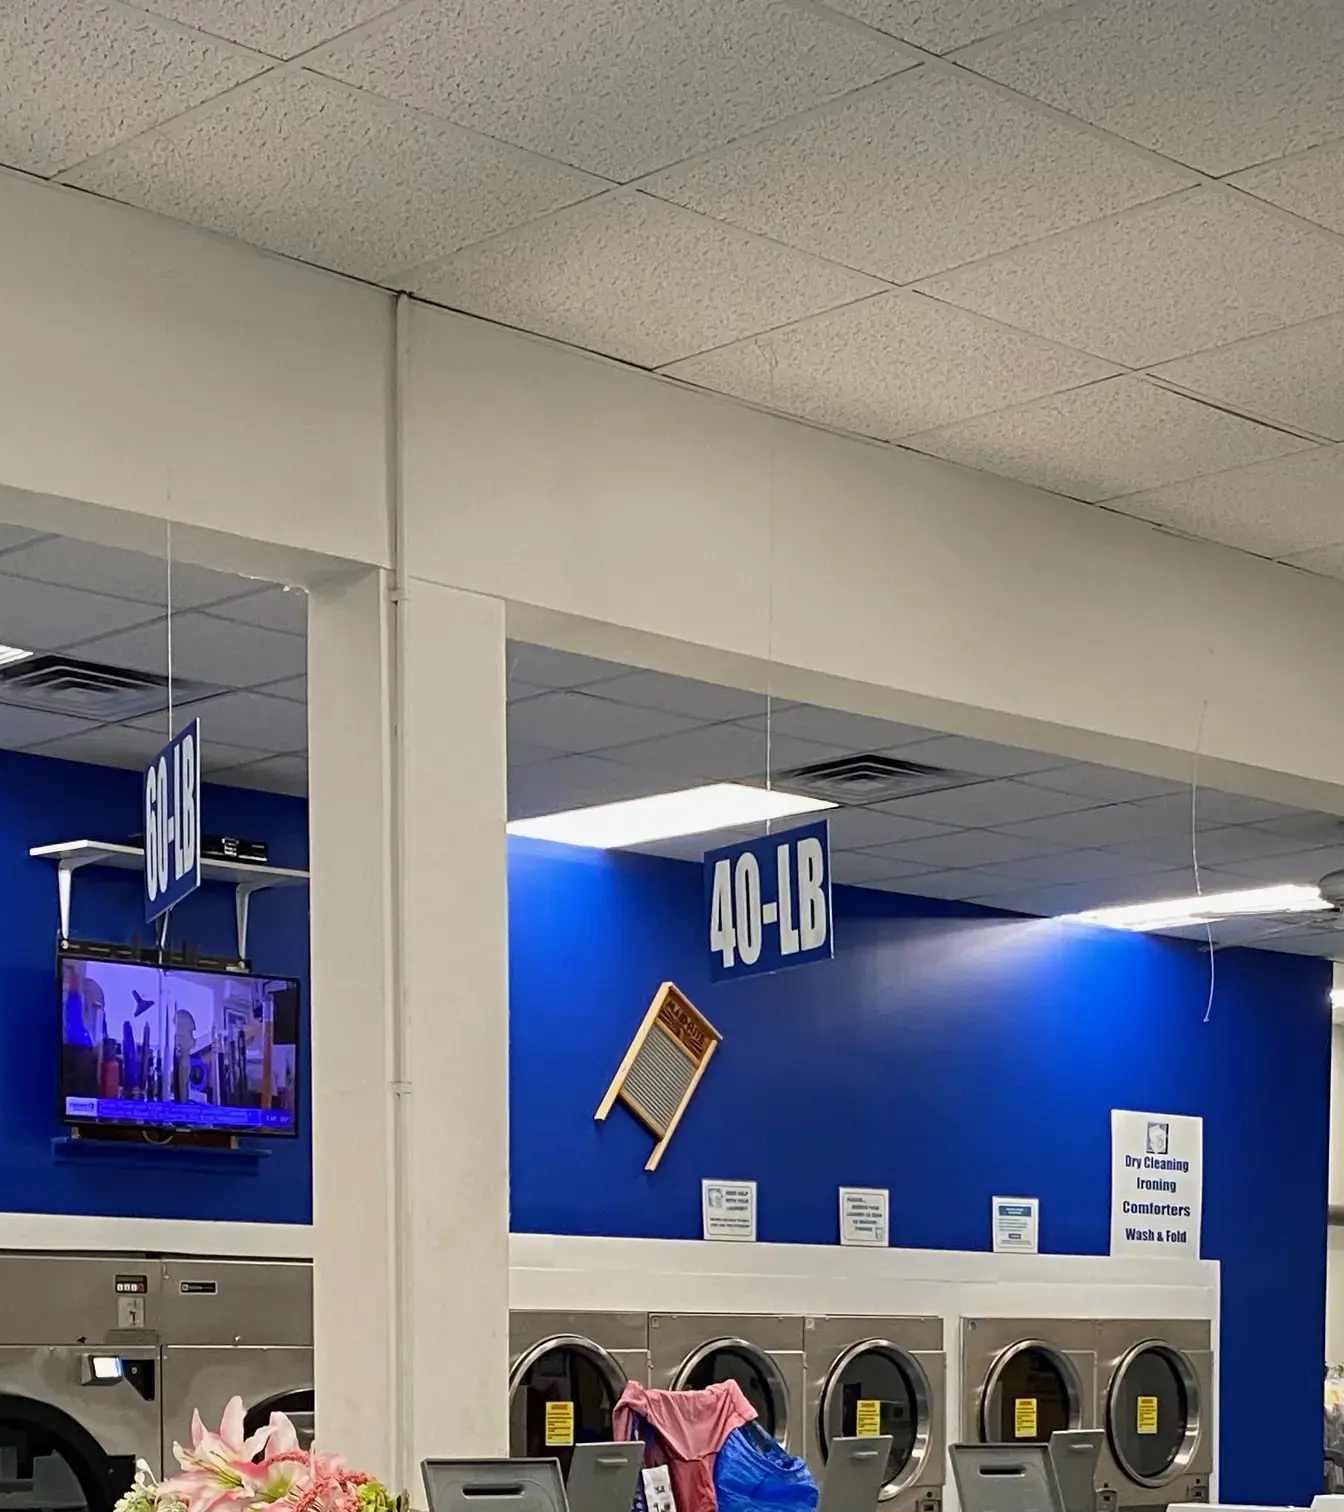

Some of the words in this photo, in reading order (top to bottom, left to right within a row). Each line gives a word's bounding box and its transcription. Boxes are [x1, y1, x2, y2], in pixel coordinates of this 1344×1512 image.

[146, 734, 195, 902] 60-LB
[710, 837, 827, 968] 40-LB
[1125, 1155, 1142, 1169] Dry
[1144, 1156, 1189, 1173] Cleaning
[1137, 1177, 1176, 1193] Ironing
[1122, 1200, 1191, 1217] Comforters
[1125, 1228, 1155, 1241] Wash
[1156, 1231, 1164, 1242] &
[1166, 1230, 1187, 1243] Fold
